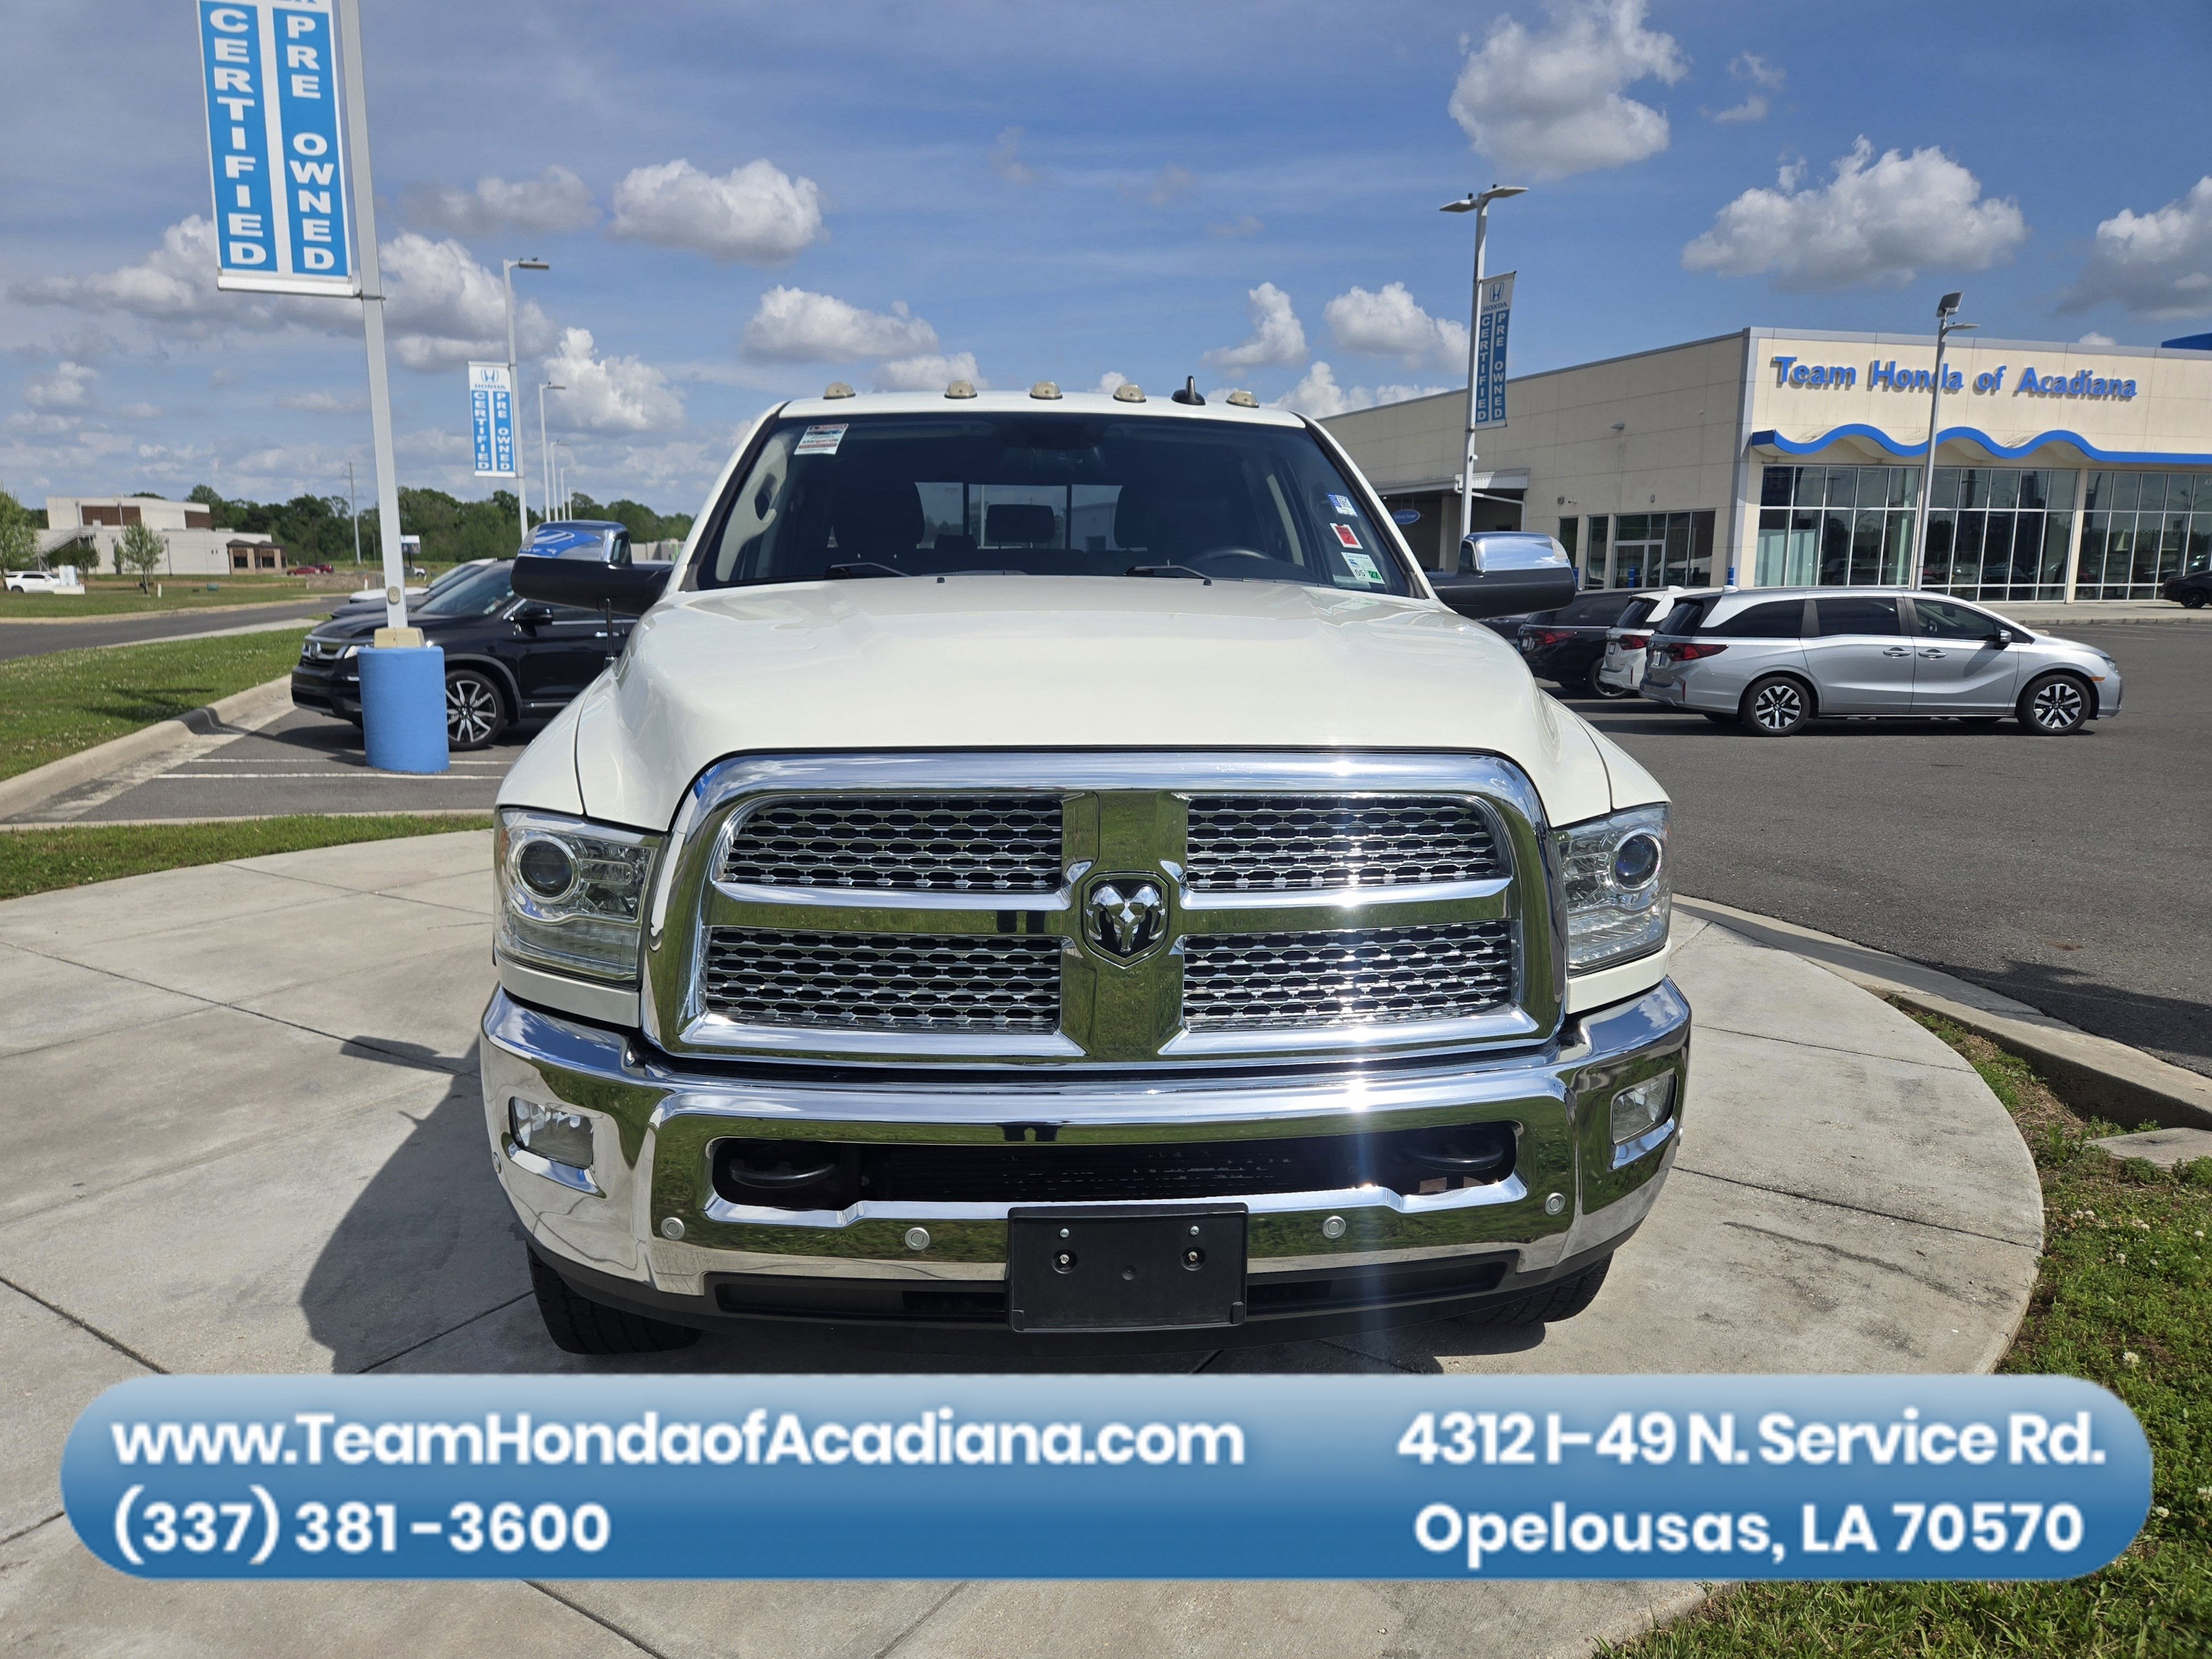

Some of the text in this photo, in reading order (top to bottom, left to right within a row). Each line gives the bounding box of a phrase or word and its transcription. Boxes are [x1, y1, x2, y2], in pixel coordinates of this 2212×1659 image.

[287, 14, 321, 99] PRE
[209, 8, 267, 265] CERTIFIED
[289, 132, 335, 270] OWNED
[1483, 302, 1507, 312] HONDA
[1477, 316, 1491, 421] CERTIFIED
[1493, 313, 1506, 418] PRE OWNED
[1773, 356, 2137, 397] Team Honda of Acadiana
[474, 392, 490, 470] CERTIFIED
[496, 393, 511, 471] PRE OWNED
